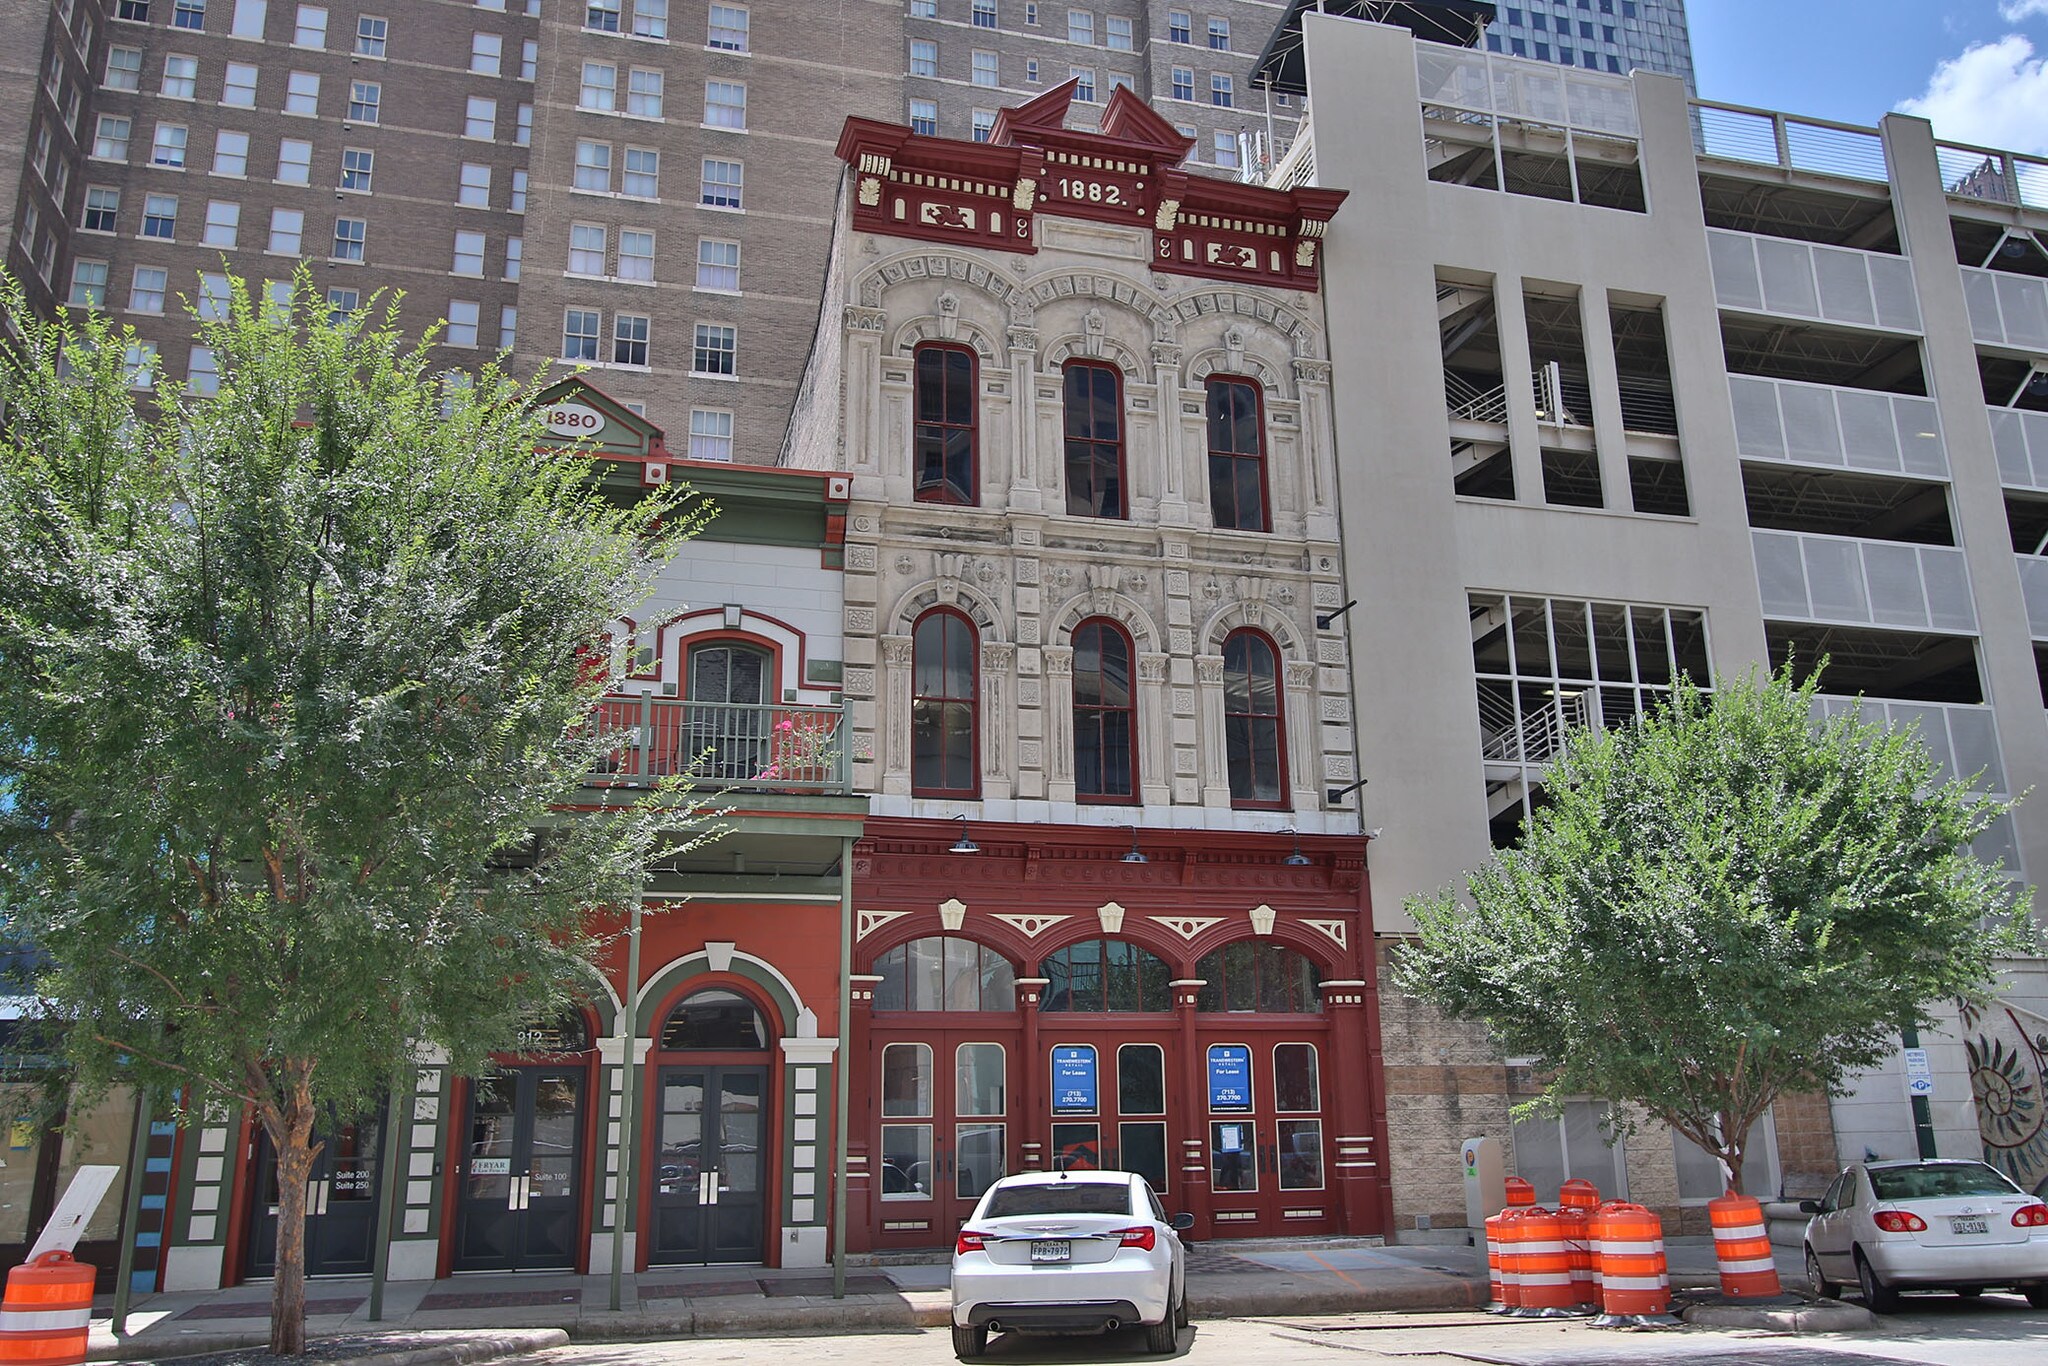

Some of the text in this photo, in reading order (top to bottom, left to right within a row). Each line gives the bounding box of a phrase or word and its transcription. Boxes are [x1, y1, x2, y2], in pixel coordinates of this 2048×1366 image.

[547, 411, 596, 428] 1880
[478, 1161, 506, 1169] FRYAR
[336, 1171, 369, 1179] Suite 200
[335, 1181, 369, 1190] Suite 250
